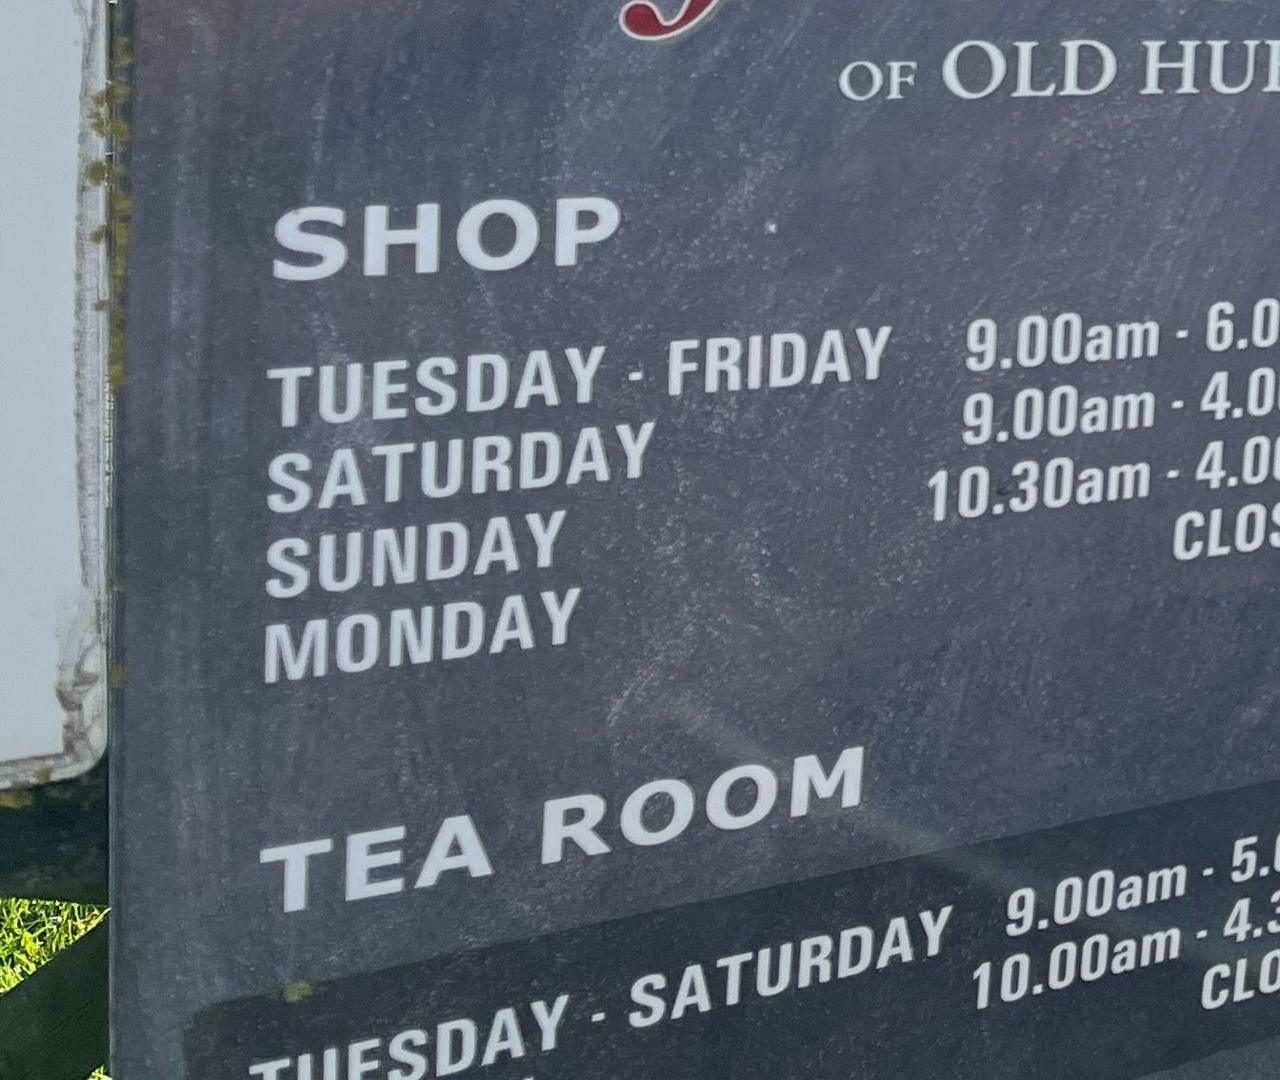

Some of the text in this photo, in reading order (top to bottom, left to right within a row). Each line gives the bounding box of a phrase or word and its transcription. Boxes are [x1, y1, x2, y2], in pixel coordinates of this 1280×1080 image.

[838, 60, 917, 102] OF
[942, 39, 1117, 99] OLD
[273, 196, 620, 281] SHOP
[267, 345, 606, 427] TUESDAY
[668, 325, 892, 396] FRIDAY
[965, 312, 1160, 372] 9.00am
[962, 384, 1155, 445] 9.00am
[267, 422, 656, 514] SATURDAY
[928, 456, 1150, 522] 10.30am
[265, 509, 566, 599] SUNDAY
[264, 587, 581, 684] MONDAY
[259, 746, 865, 913] TEA ROOM
[1006, 865, 1187, 938] 9.00am
[628, 905, 954, 1028] SATURDAY
[972, 927, 1181, 1010] 10.00am
